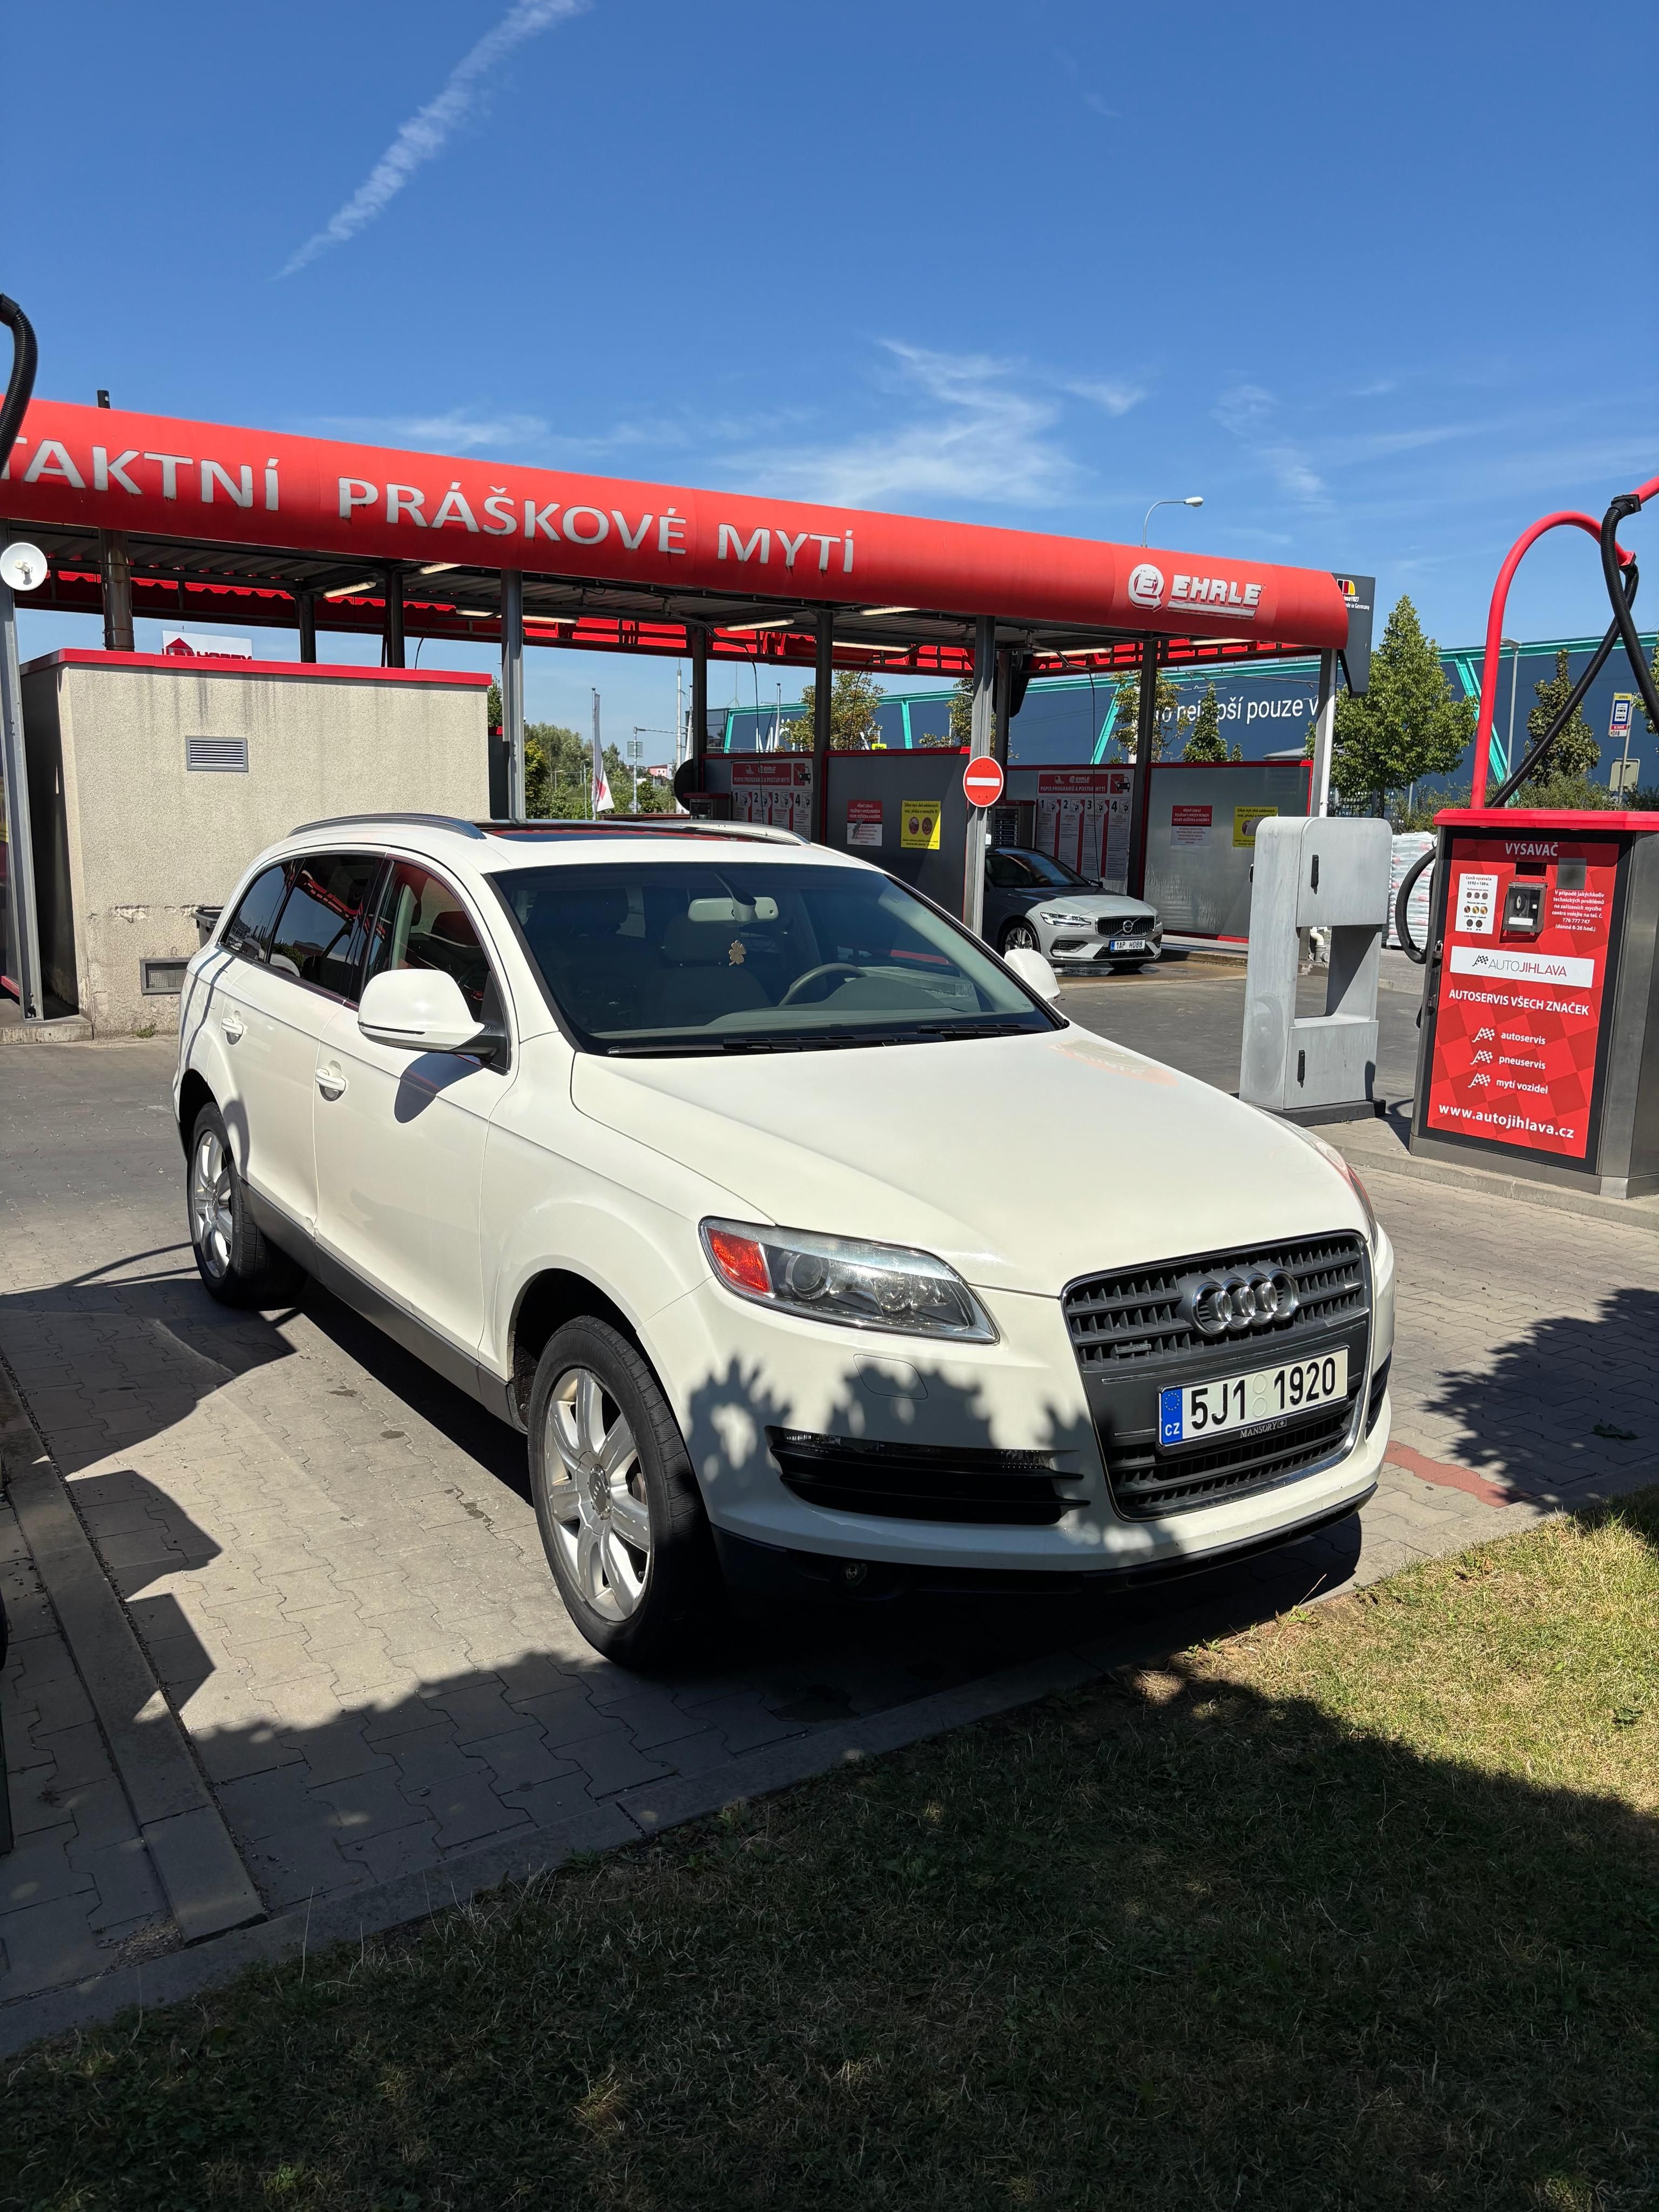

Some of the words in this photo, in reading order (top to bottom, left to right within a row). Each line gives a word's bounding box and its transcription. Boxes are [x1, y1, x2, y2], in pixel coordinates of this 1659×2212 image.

[339, 477, 686, 554] PRÁŠKOVÉ
[718, 523, 854, 573] MYTÍ
[1171, 574, 1263, 608] EHRLE
[1355, 603, 1370, 611] Germany
[1246, 699, 1303, 724] pouze
[735, 792, 738, 802] 1
[754, 793, 758, 802] 2
[774, 793, 778, 803] 3
[795, 794, 800, 806] 4
[1041, 800, 1044, 808] 1
[1064, 800, 1068, 809] 2
[1087, 800, 1091, 809] 3
[1111, 801, 1117, 812] 4
[1505, 842, 1559, 857] VYSAVAČ
[1449, 989, 1508, 1005] AUTOSERVIS
[1510, 995, 1544, 1010] VŠECH
[1546, 1001, 1589, 1016] ZNAČEK
[1501, 1032, 1546, 1045] autoservis
[1499, 1056, 1546, 1069] pneuservis
[1496, 1079, 1516, 1089] mytí
[1517, 1083, 1548, 1094] vozidel
[1439, 1104, 1574, 1138] www.autojihlava.cz
[1191, 1383, 1245, 1430] 5J1
[1273, 1357, 1336, 1410] 1920
[1165, 1422, 1180, 1437] CZ
[1240, 1421, 1277, 1439] MANSORY
